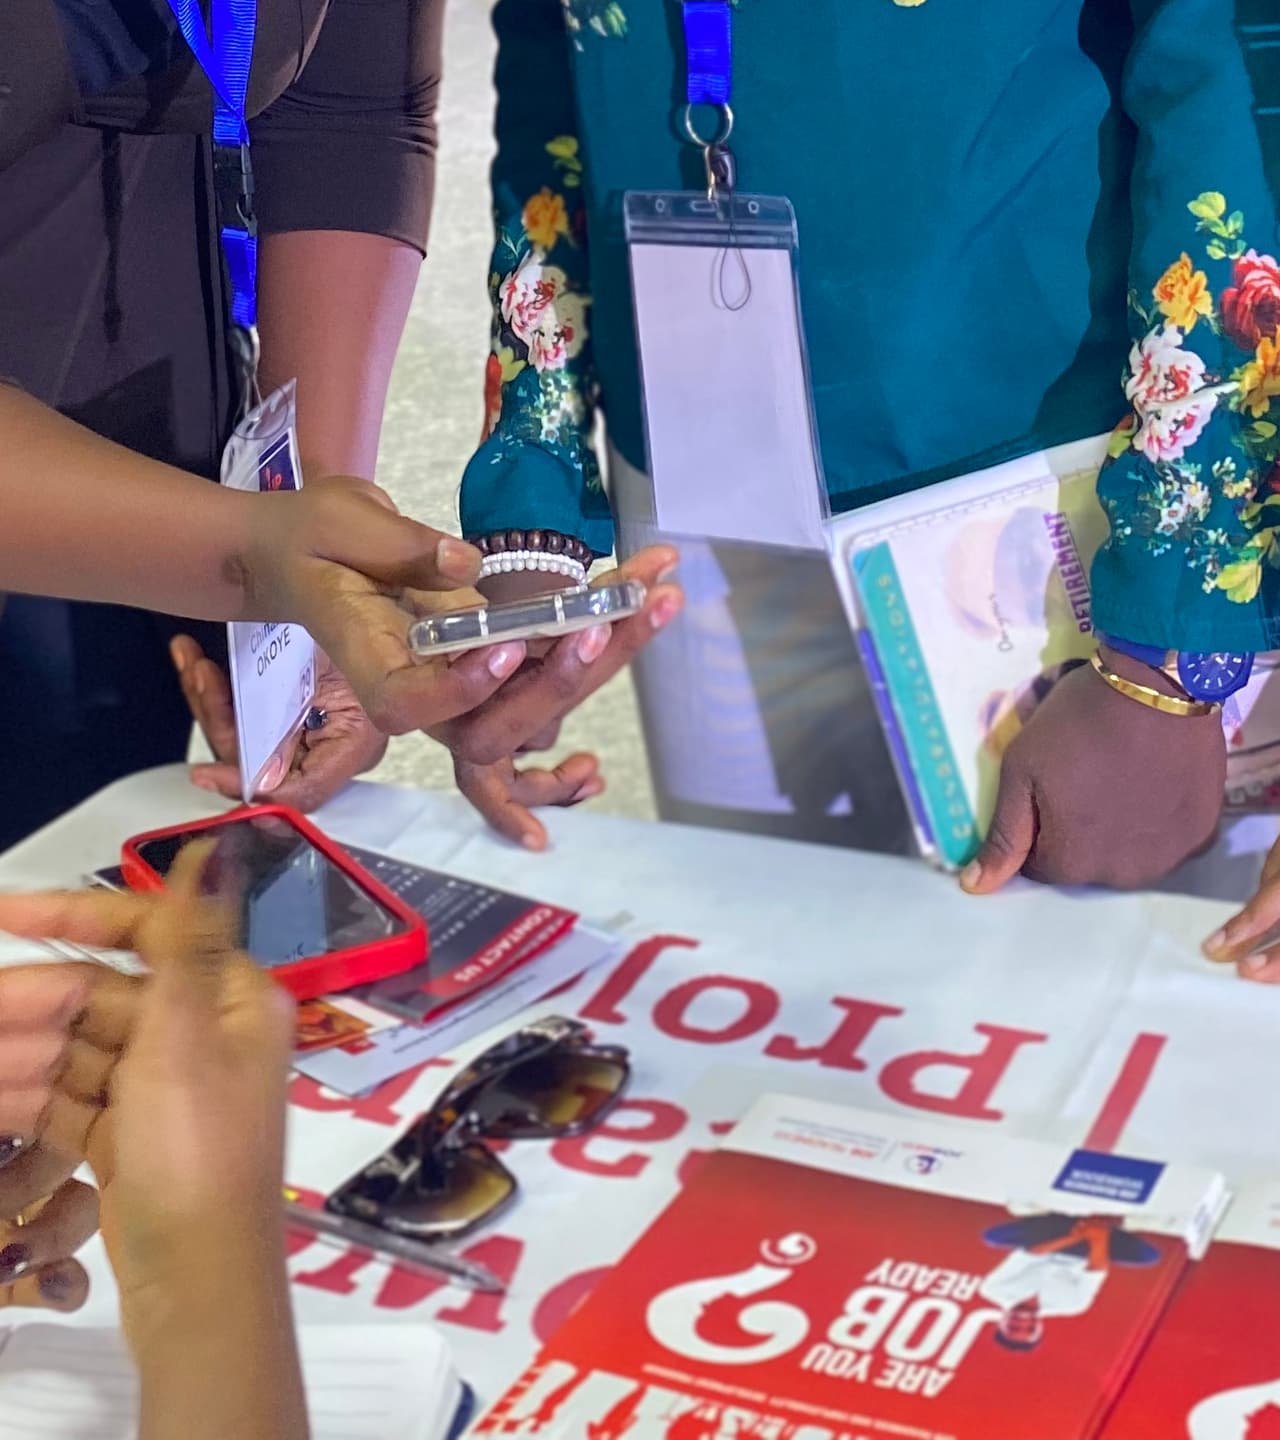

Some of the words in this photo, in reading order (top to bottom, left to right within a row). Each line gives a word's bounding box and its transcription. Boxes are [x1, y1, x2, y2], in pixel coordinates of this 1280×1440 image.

[1043, 511, 1092, 633] RETIREMENT
[257, 625, 291, 677] OKOYE
[478, 907, 553, 967] CONTACT
[453, 963, 483, 982] US
[578, 933, 1048, 1122] Proj
[864, 1257, 982, 1302] READY
[826, 1284, 1004, 1369] JOB
[800, 1343, 873, 1384] YOU
[873, 1360, 955, 1399] ARE
